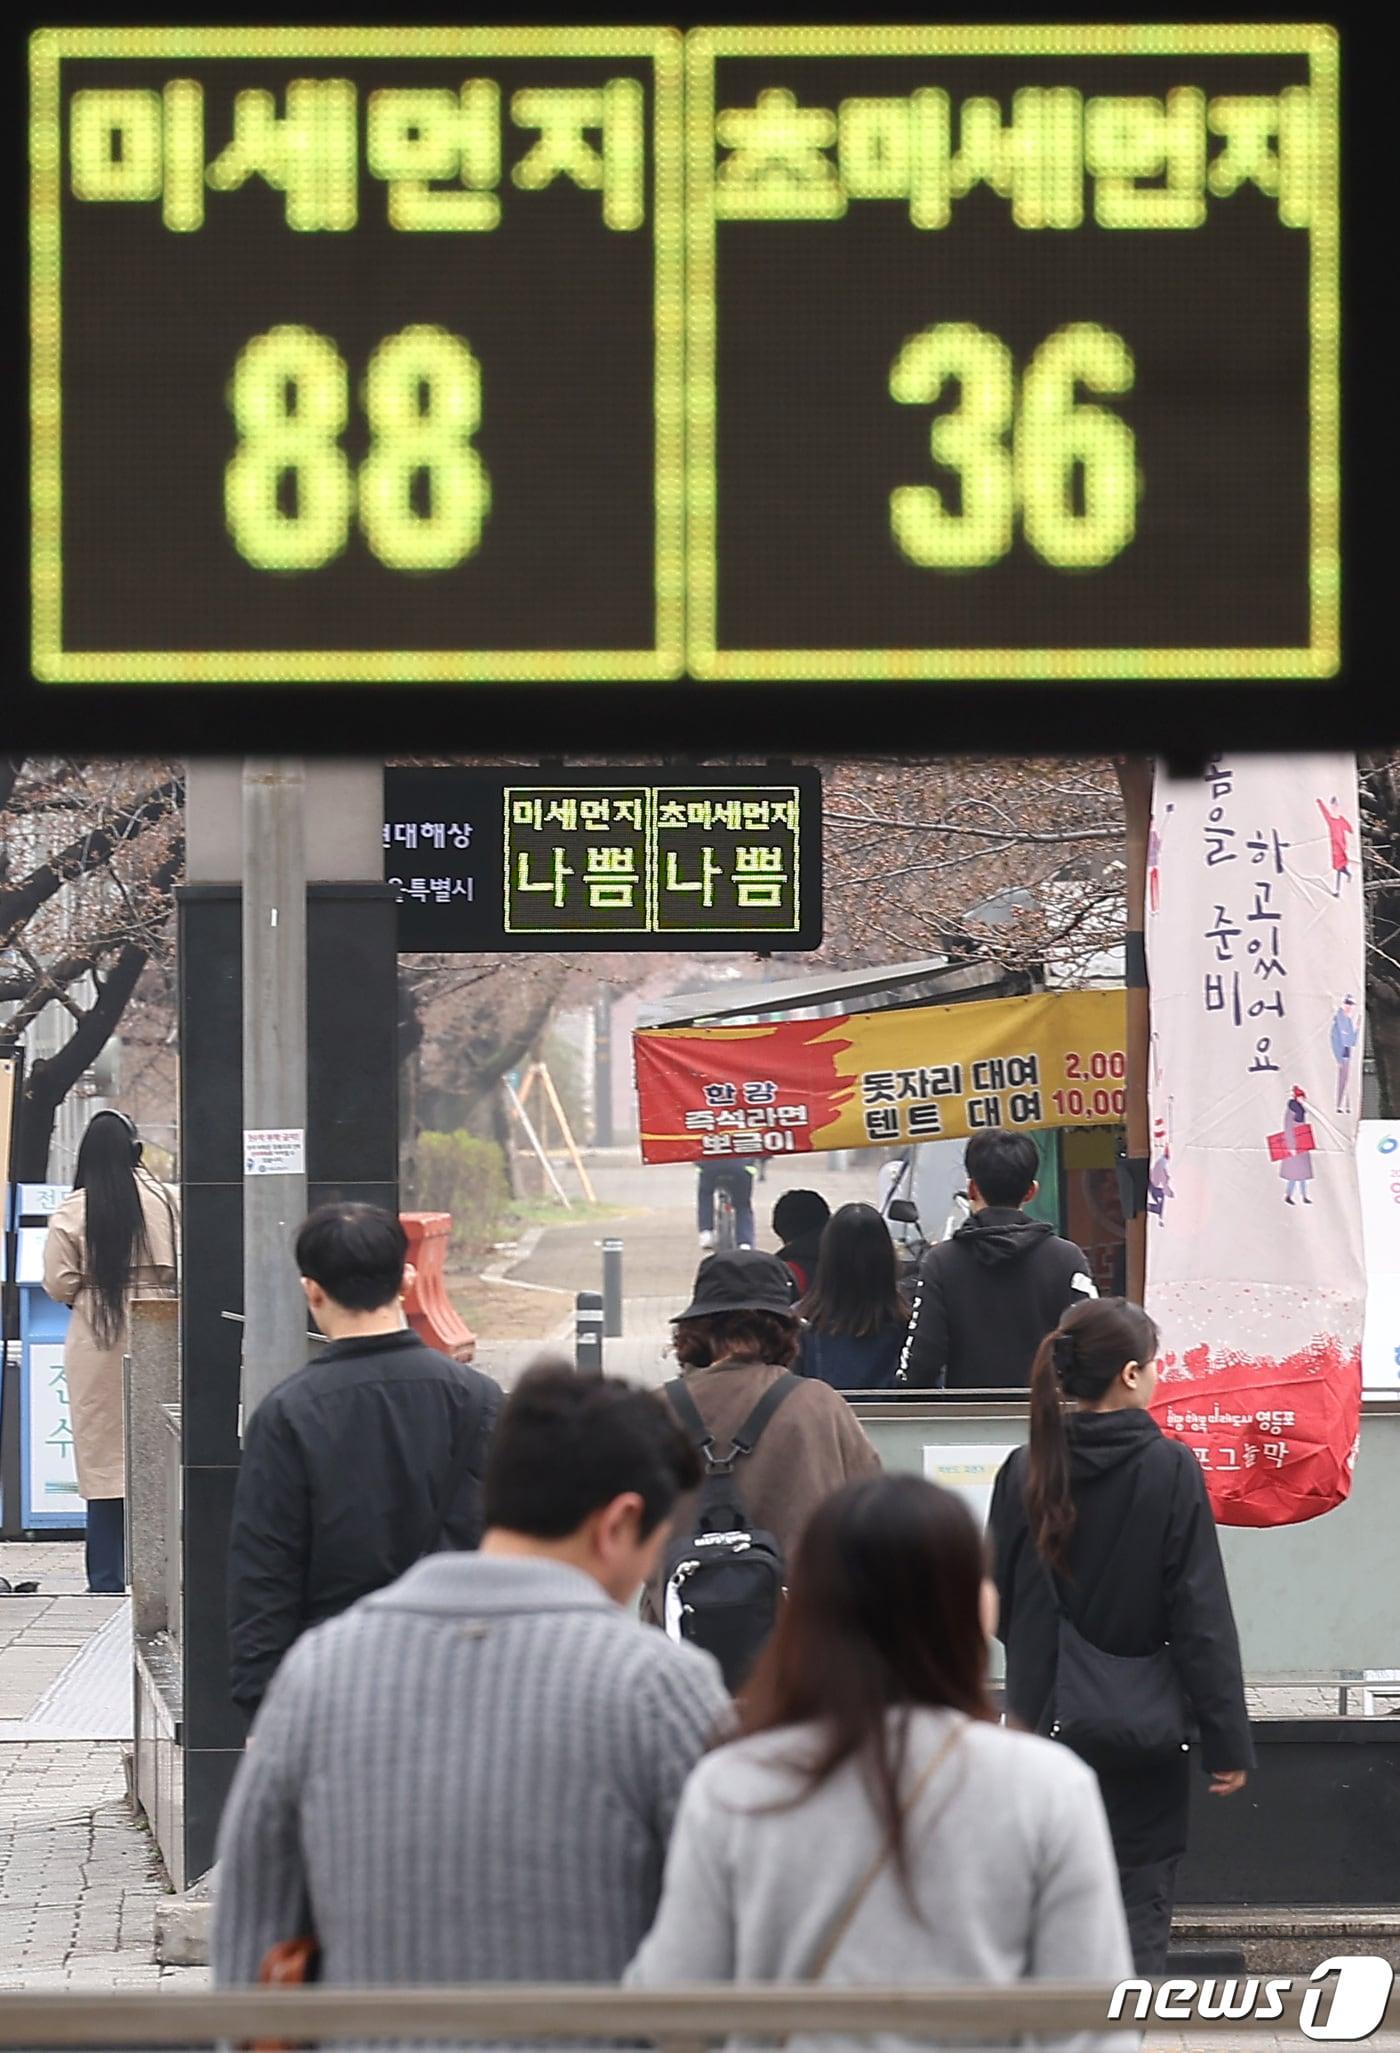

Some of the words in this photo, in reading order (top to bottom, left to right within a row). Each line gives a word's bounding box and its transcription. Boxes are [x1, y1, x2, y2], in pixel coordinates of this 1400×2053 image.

[70, 78, 644, 232] 미세먼지
[714, 87, 1311, 230] 초미세먼지
[226, 324, 490, 571] 88
[890, 322, 1137, 568] 36
[513, 798, 642, 831] 미세먼지
[657, 800, 798, 830] 초미세먼지
[517, 847, 639, 907] 나쁨
[666, 847, 788, 907] 나쁨
[1205, 905, 1242, 1026] 준비
[1246, 829, 1290, 1072] 하고있어요
[862, 1063, 963, 1106] 돗자리
[971, 1052, 1040, 1093] 대여
[684, 1104, 809, 1131] 즉석라면
[702, 1130, 795, 1155] 뽀글이
[865, 1103, 943, 1140] 텐트
[967, 1090, 1043, 1130] 대여
[1255, 1411, 1296, 1435] 영등포
